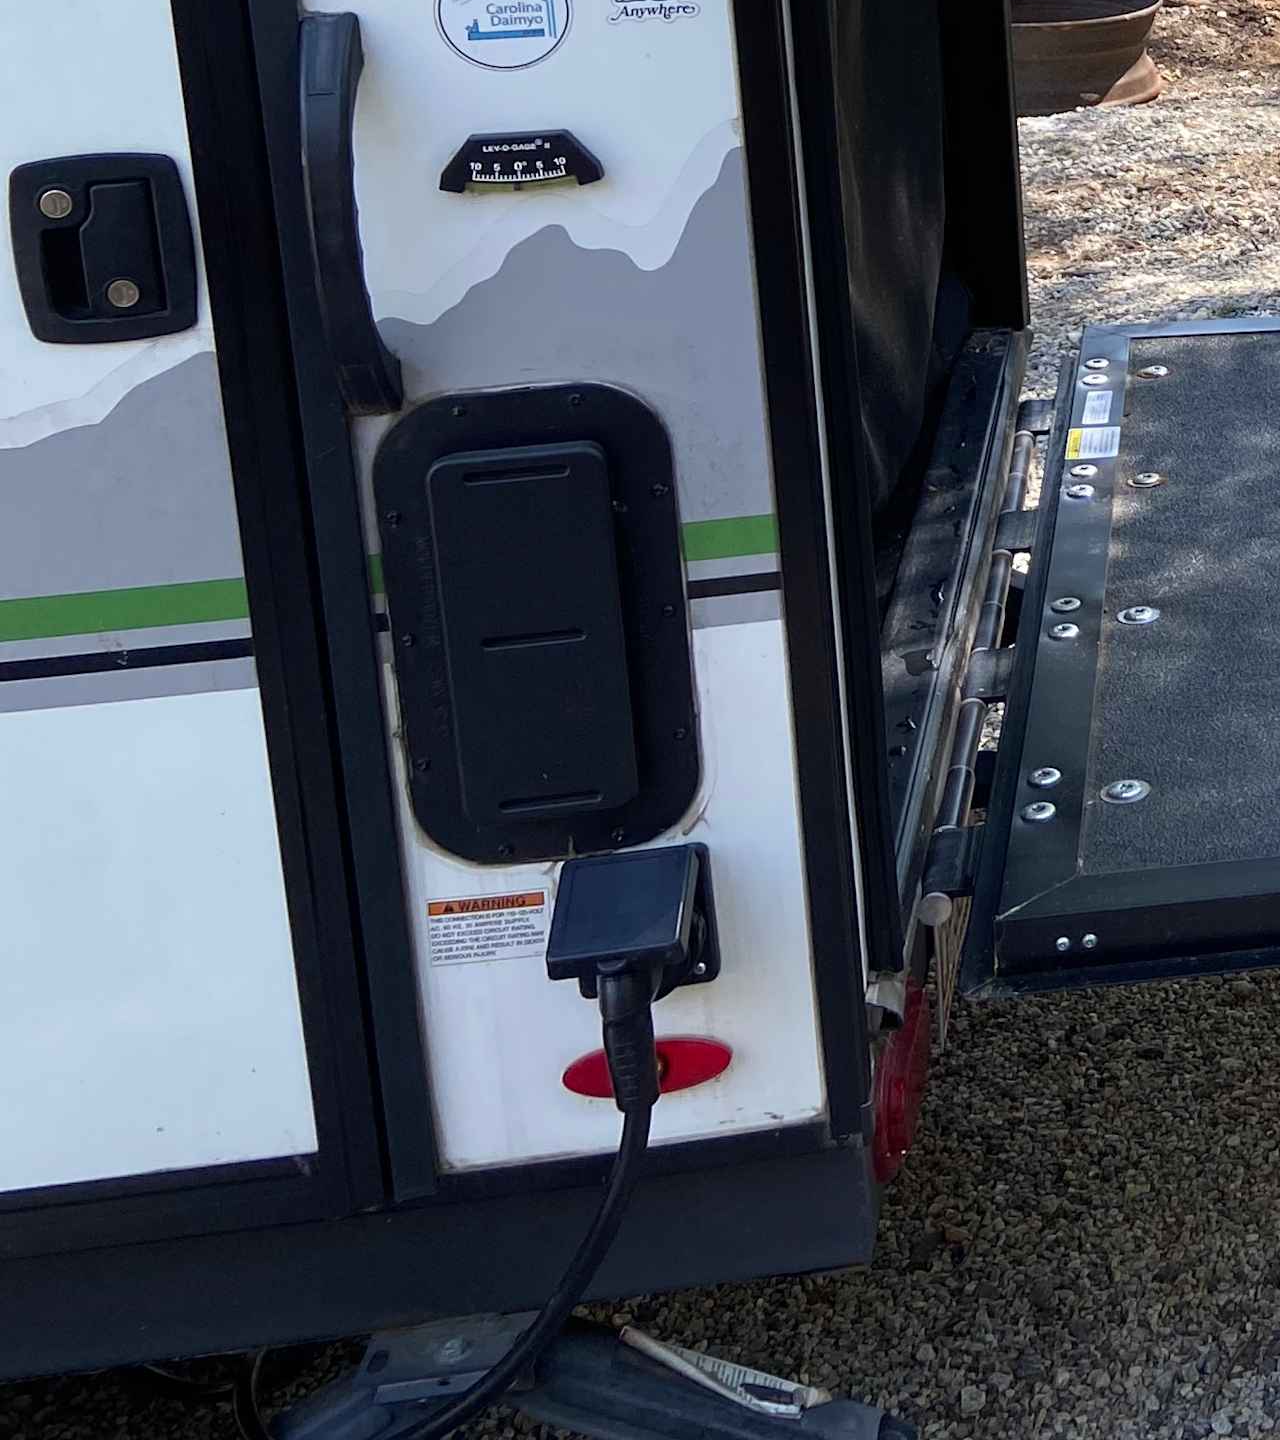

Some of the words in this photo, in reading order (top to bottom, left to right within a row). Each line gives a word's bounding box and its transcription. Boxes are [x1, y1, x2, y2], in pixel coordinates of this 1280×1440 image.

[486, 1, 543, 15] Carolina
[490, 14, 544, 28] Daimyo
[470, 162, 482, 171] 10
[493, 163, 501, 171] 5
[536, 161, 544, 169] 5
[553, 156, 566, 166] 10
[458, 895, 526, 912] WARNING
